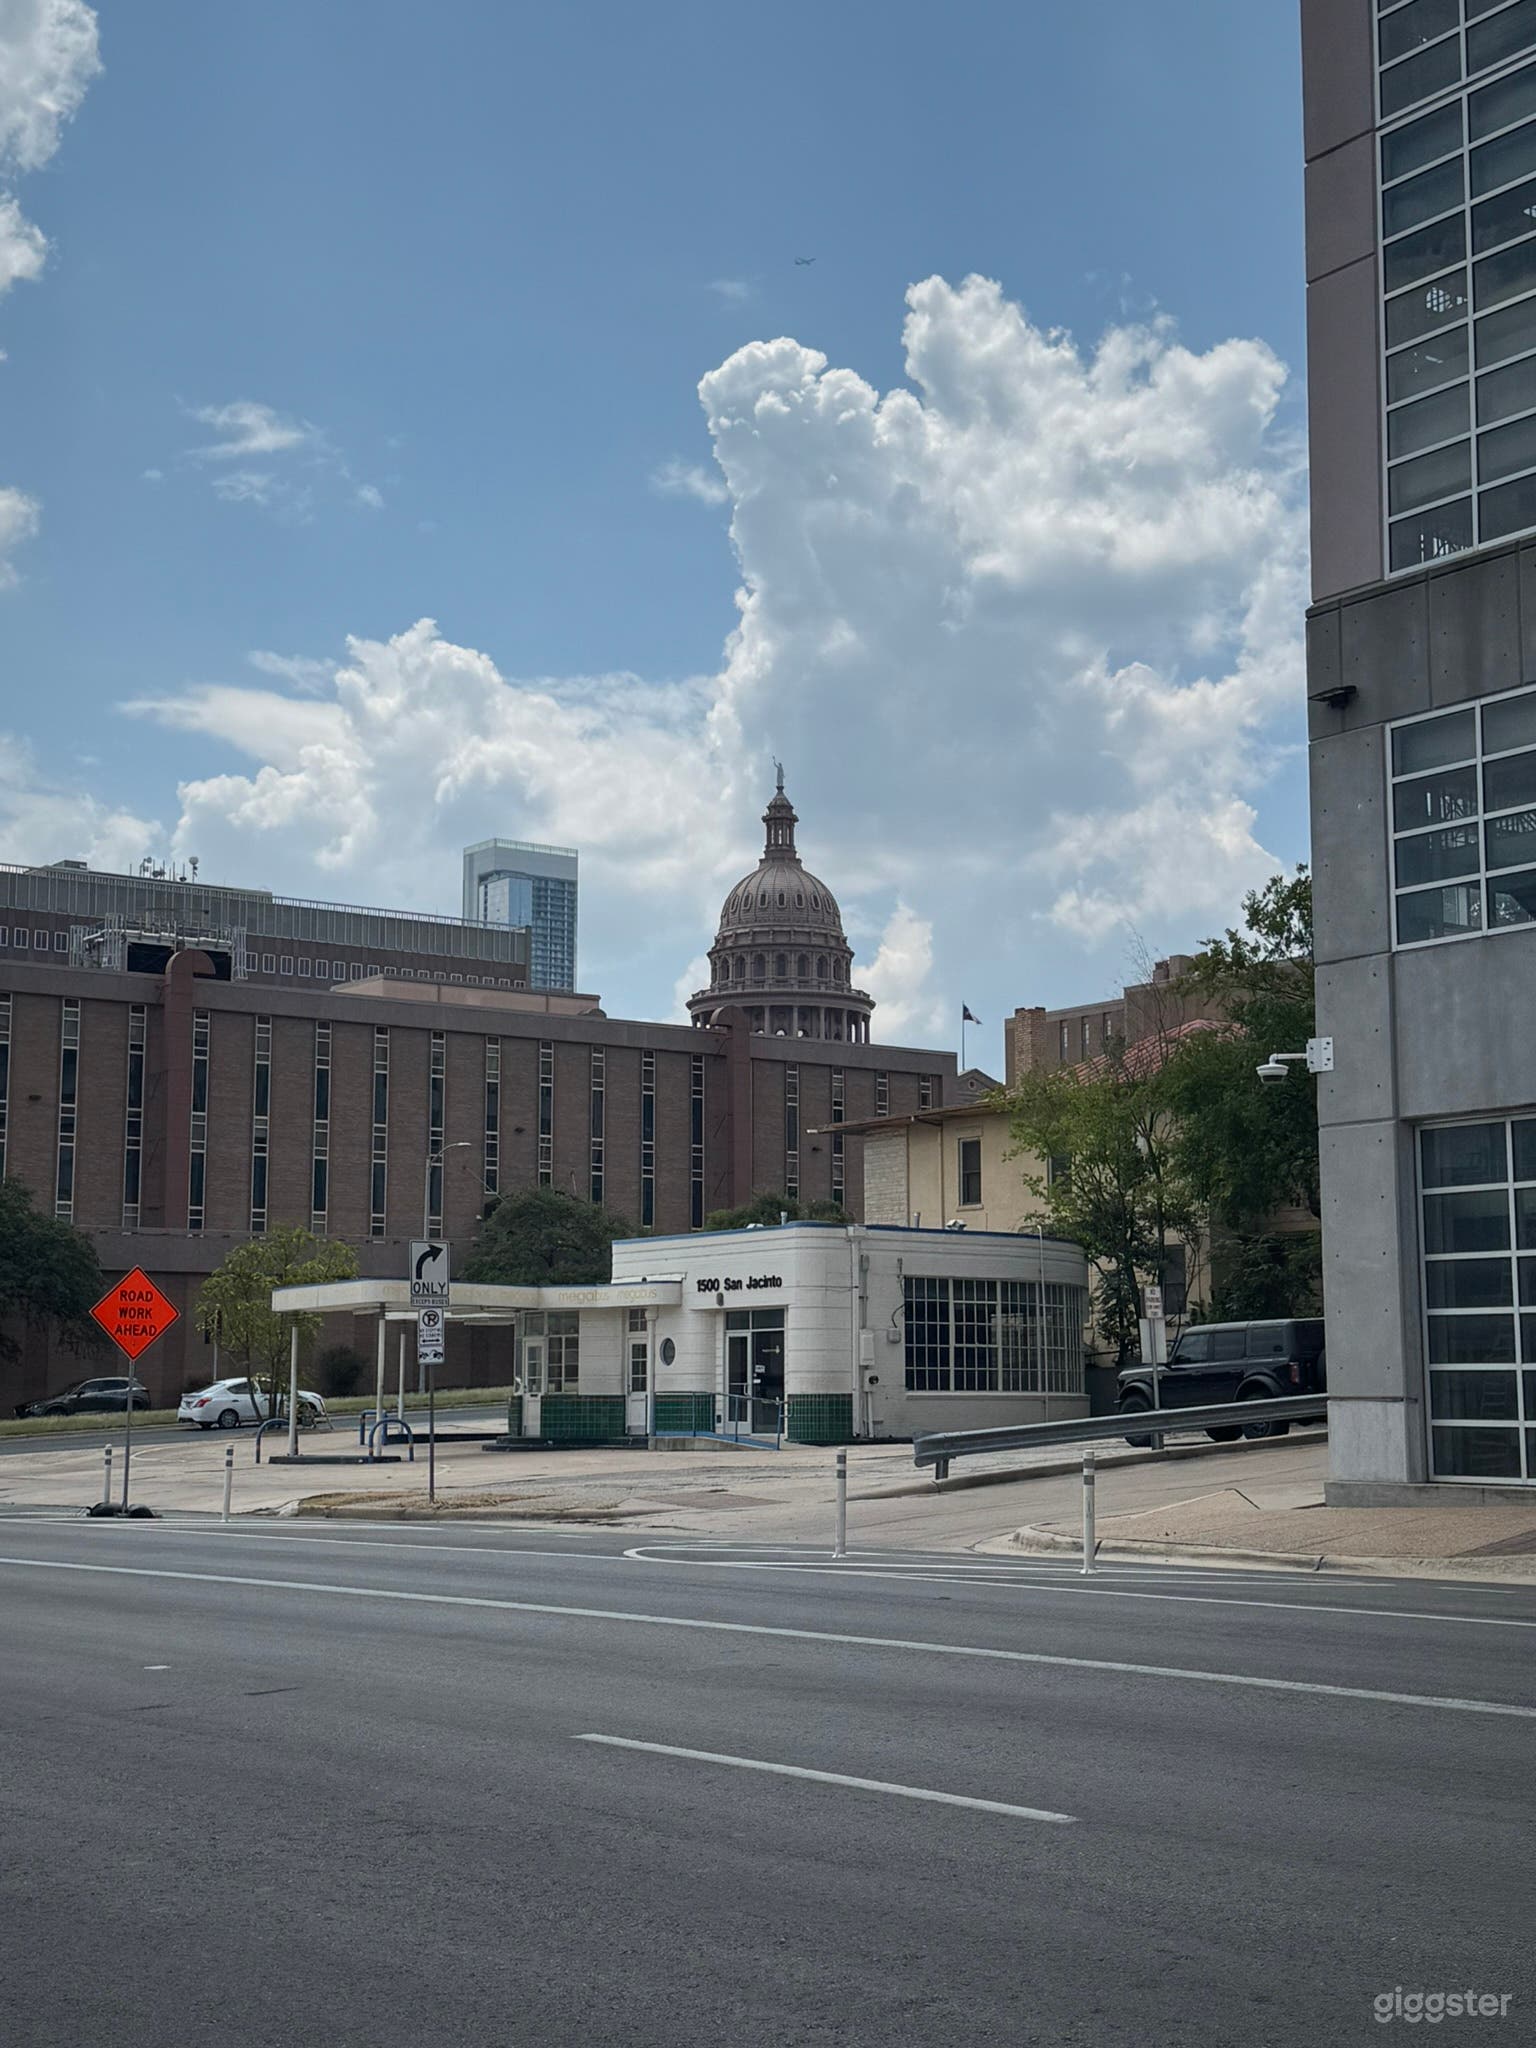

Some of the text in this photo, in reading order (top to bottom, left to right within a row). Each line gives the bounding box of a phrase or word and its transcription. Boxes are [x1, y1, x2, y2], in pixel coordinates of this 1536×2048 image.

[413, 1281, 446, 1294] ONLY
[696, 1274, 783, 1293] 1500 San Jacinto
[120, 1290, 153, 1302] ROAD
[118, 1307, 153, 1319] WORK
[115, 1324, 157, 1336] AHEAD
